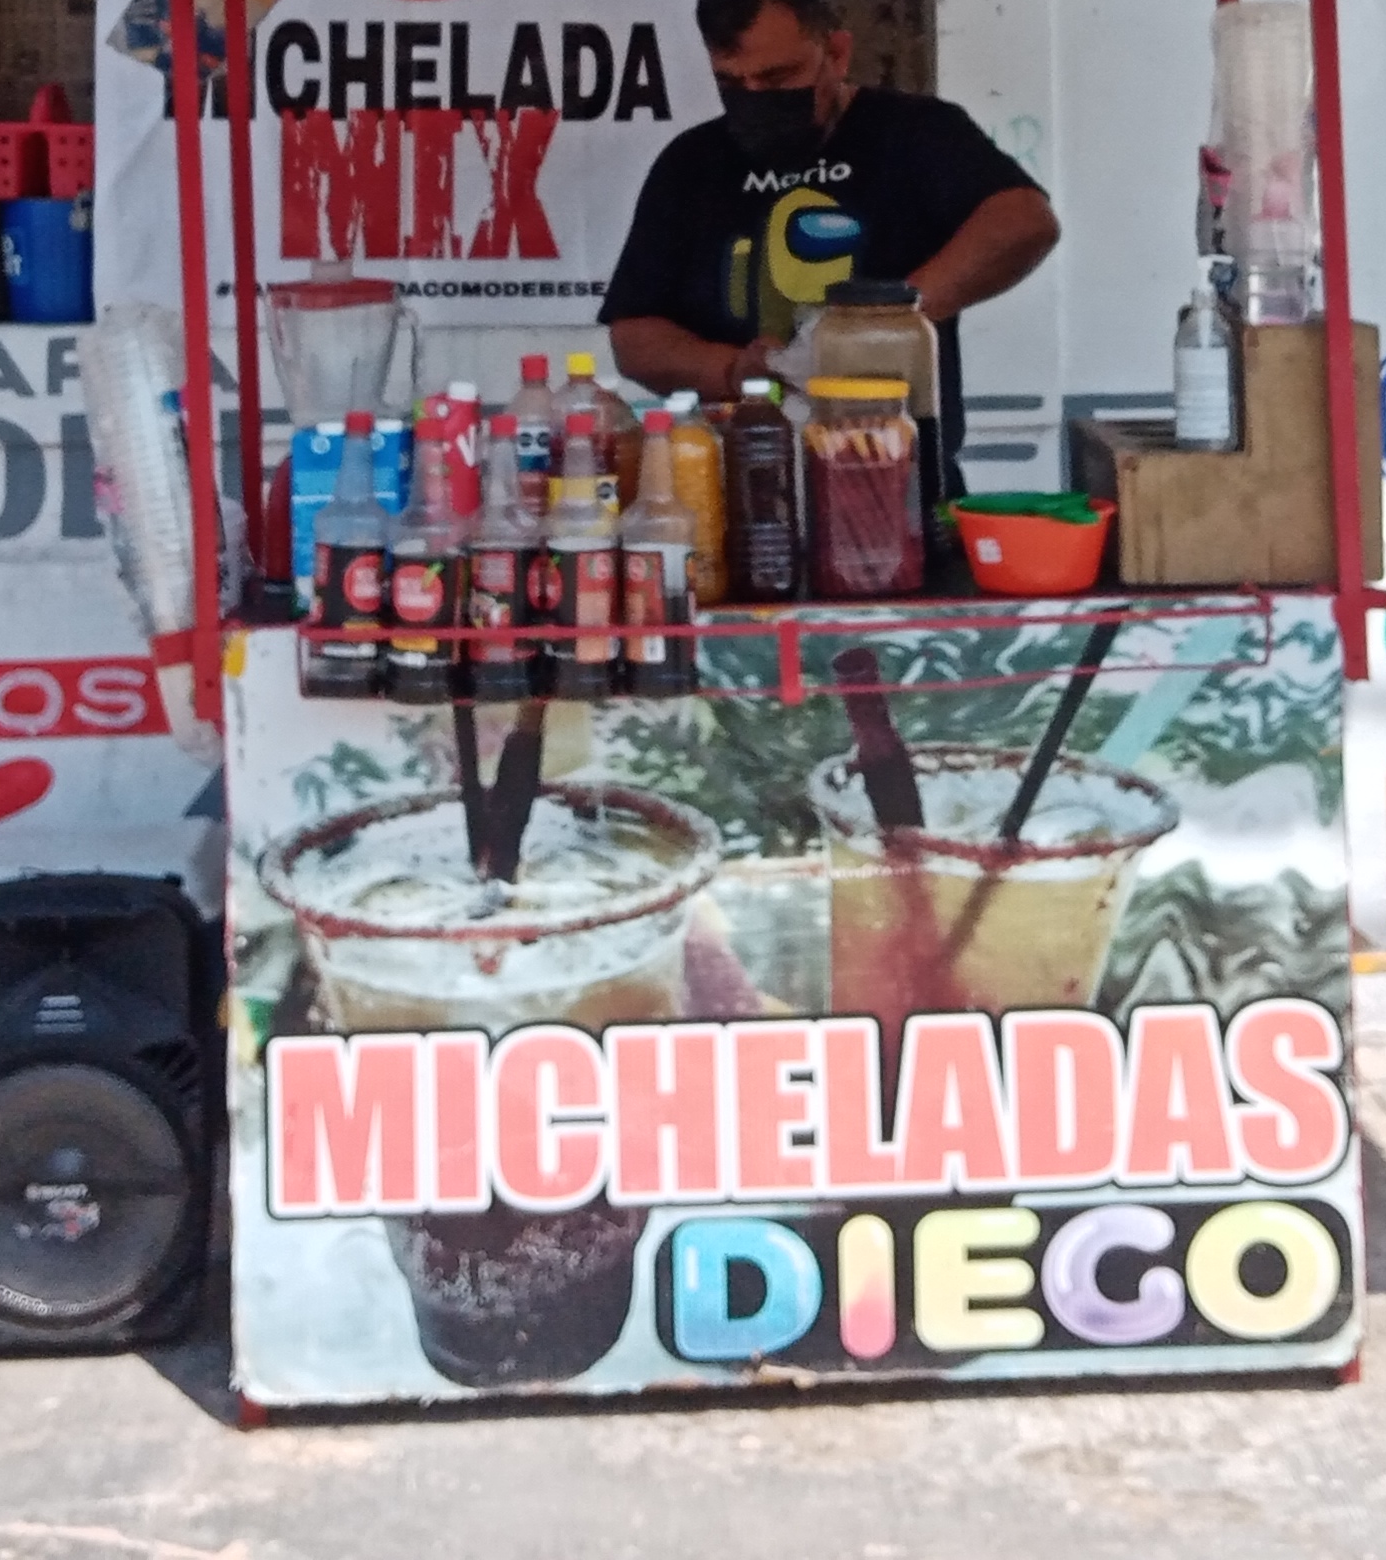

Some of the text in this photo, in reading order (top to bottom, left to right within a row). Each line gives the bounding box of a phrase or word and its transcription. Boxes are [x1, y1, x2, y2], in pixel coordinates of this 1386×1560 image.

[163, 19, 673, 122] CHELADA
[280, 107, 561, 261] MIX
[742, 157, 853, 194] Mario
[269, 1000, 1349, 1214] MICHELADAS
[668, 1200, 1342, 1362] DIEGO
